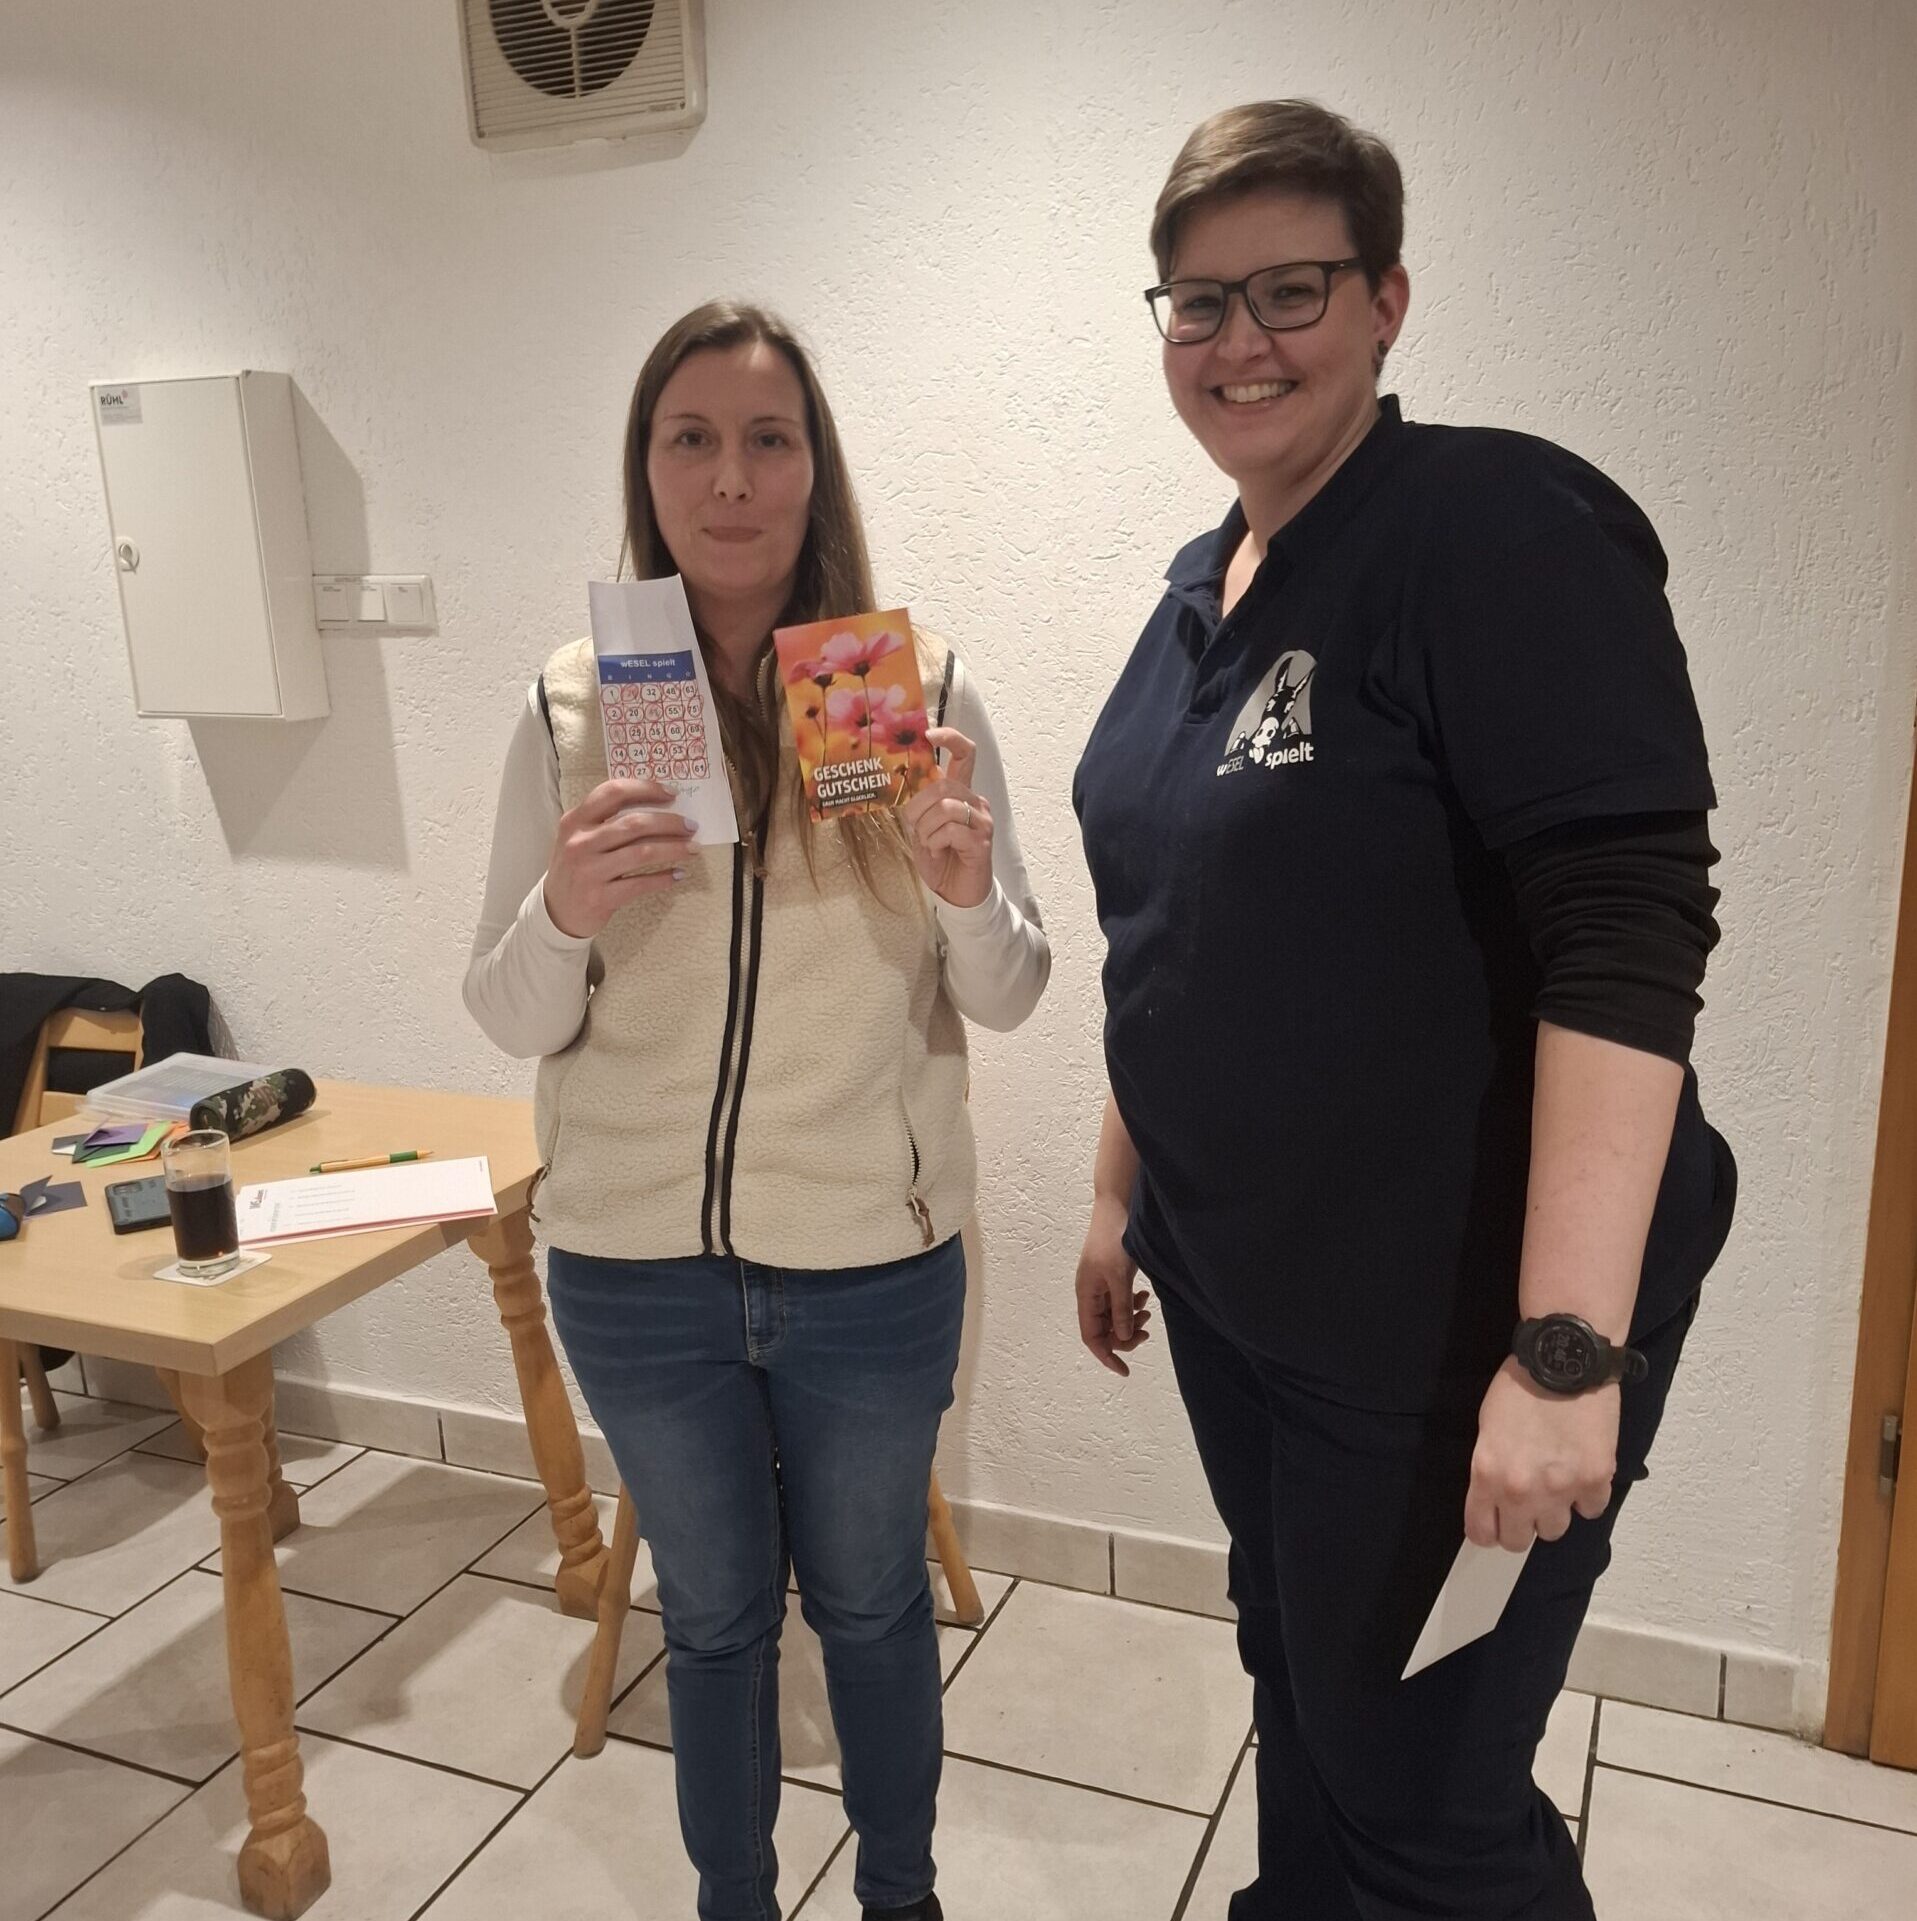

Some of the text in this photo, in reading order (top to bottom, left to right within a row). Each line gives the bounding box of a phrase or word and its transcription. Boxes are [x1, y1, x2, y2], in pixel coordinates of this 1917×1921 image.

[620, 658, 675, 668] wESEL spielt
[630, 709, 639, 717] 20
[615, 750, 623, 758] 14
[1265, 741, 1314, 770] spielt
[814, 756, 884, 781] GESCHENK
[817, 773, 892, 798] GUTSCHEIN
